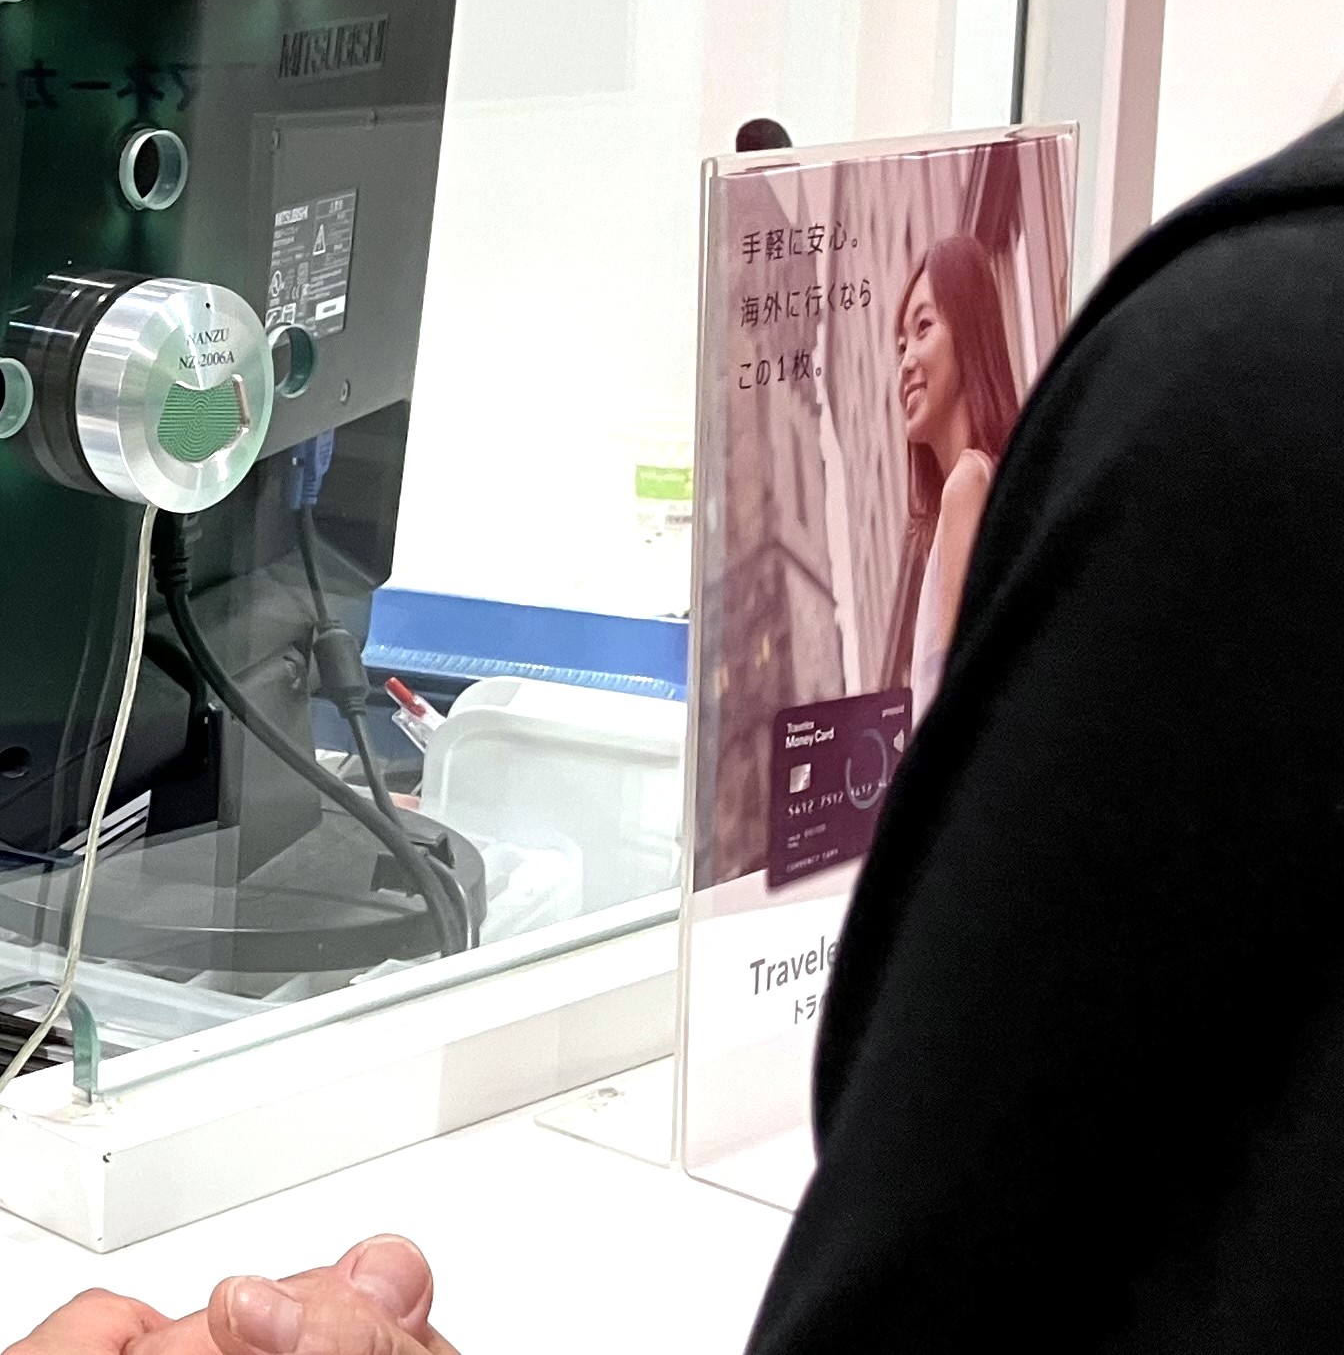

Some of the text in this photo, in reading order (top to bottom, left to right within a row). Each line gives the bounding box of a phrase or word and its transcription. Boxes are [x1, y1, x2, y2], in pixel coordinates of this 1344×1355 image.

[740, 221, 859, 266] 手軽に安心。
[739, 278, 873, 328] 海外に行くなら
[178, 350, 235, 371] NZ2006A
[785, 727, 835, 749] Money Card
[794, 993, 823, 1025] トラ
